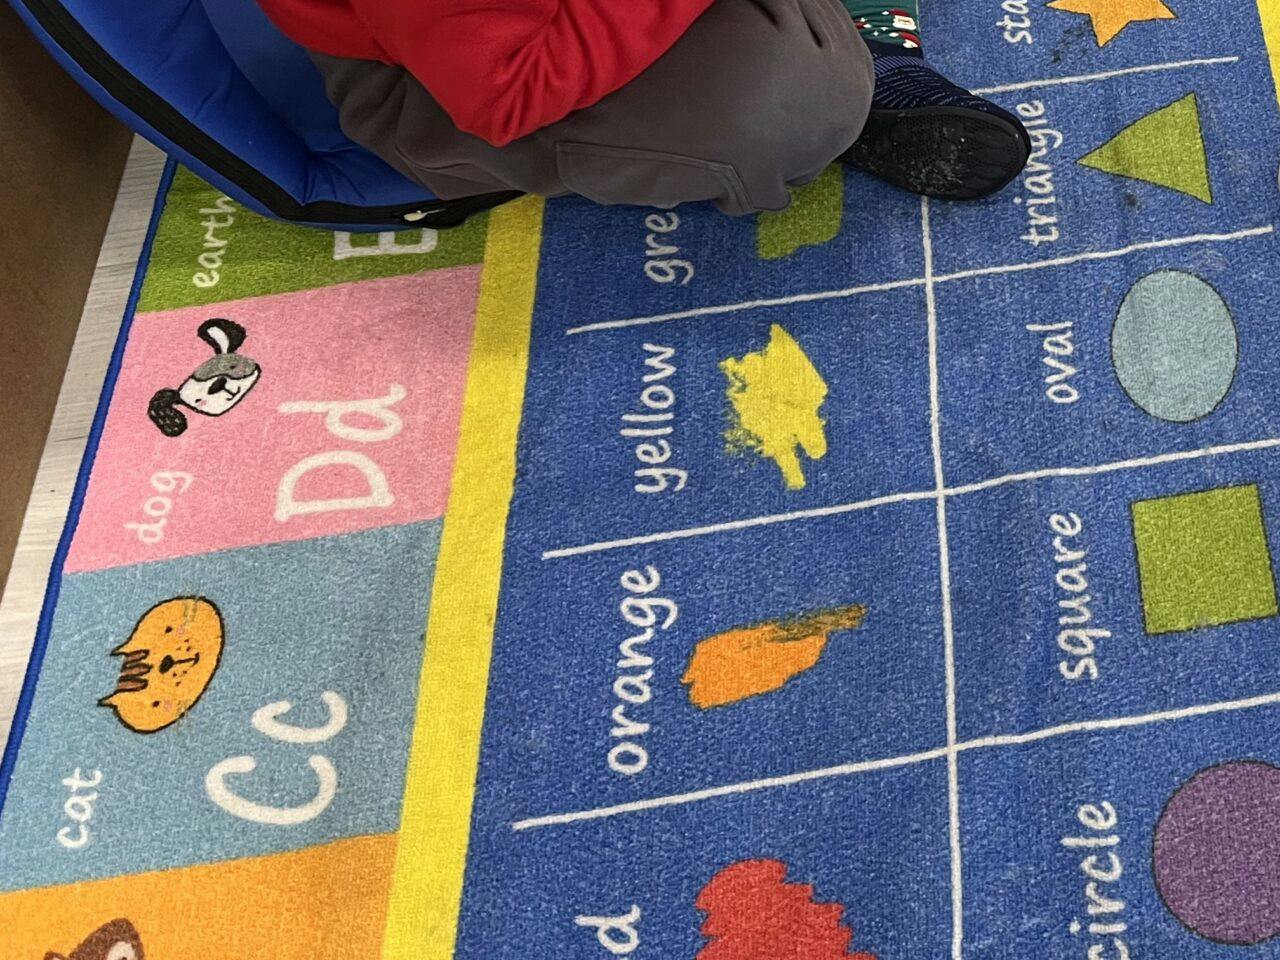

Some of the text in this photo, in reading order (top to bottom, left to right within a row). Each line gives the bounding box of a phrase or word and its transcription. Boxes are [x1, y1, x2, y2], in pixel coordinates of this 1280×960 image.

[1014, 99, 1063, 247] triangle
[332, 227, 439, 262] E
[643, 211, 695, 285] gre
[634, 341, 686, 496] yellow
[1026, 320, 1074, 406] oval
[123, 468, 195, 546] dog
[274, 383, 409, 521] Dd
[1048, 510, 1112, 685] square
[607, 564, 679, 777] orange
[56, 768, 103, 848] cat
[204, 688, 350, 826] Cc
